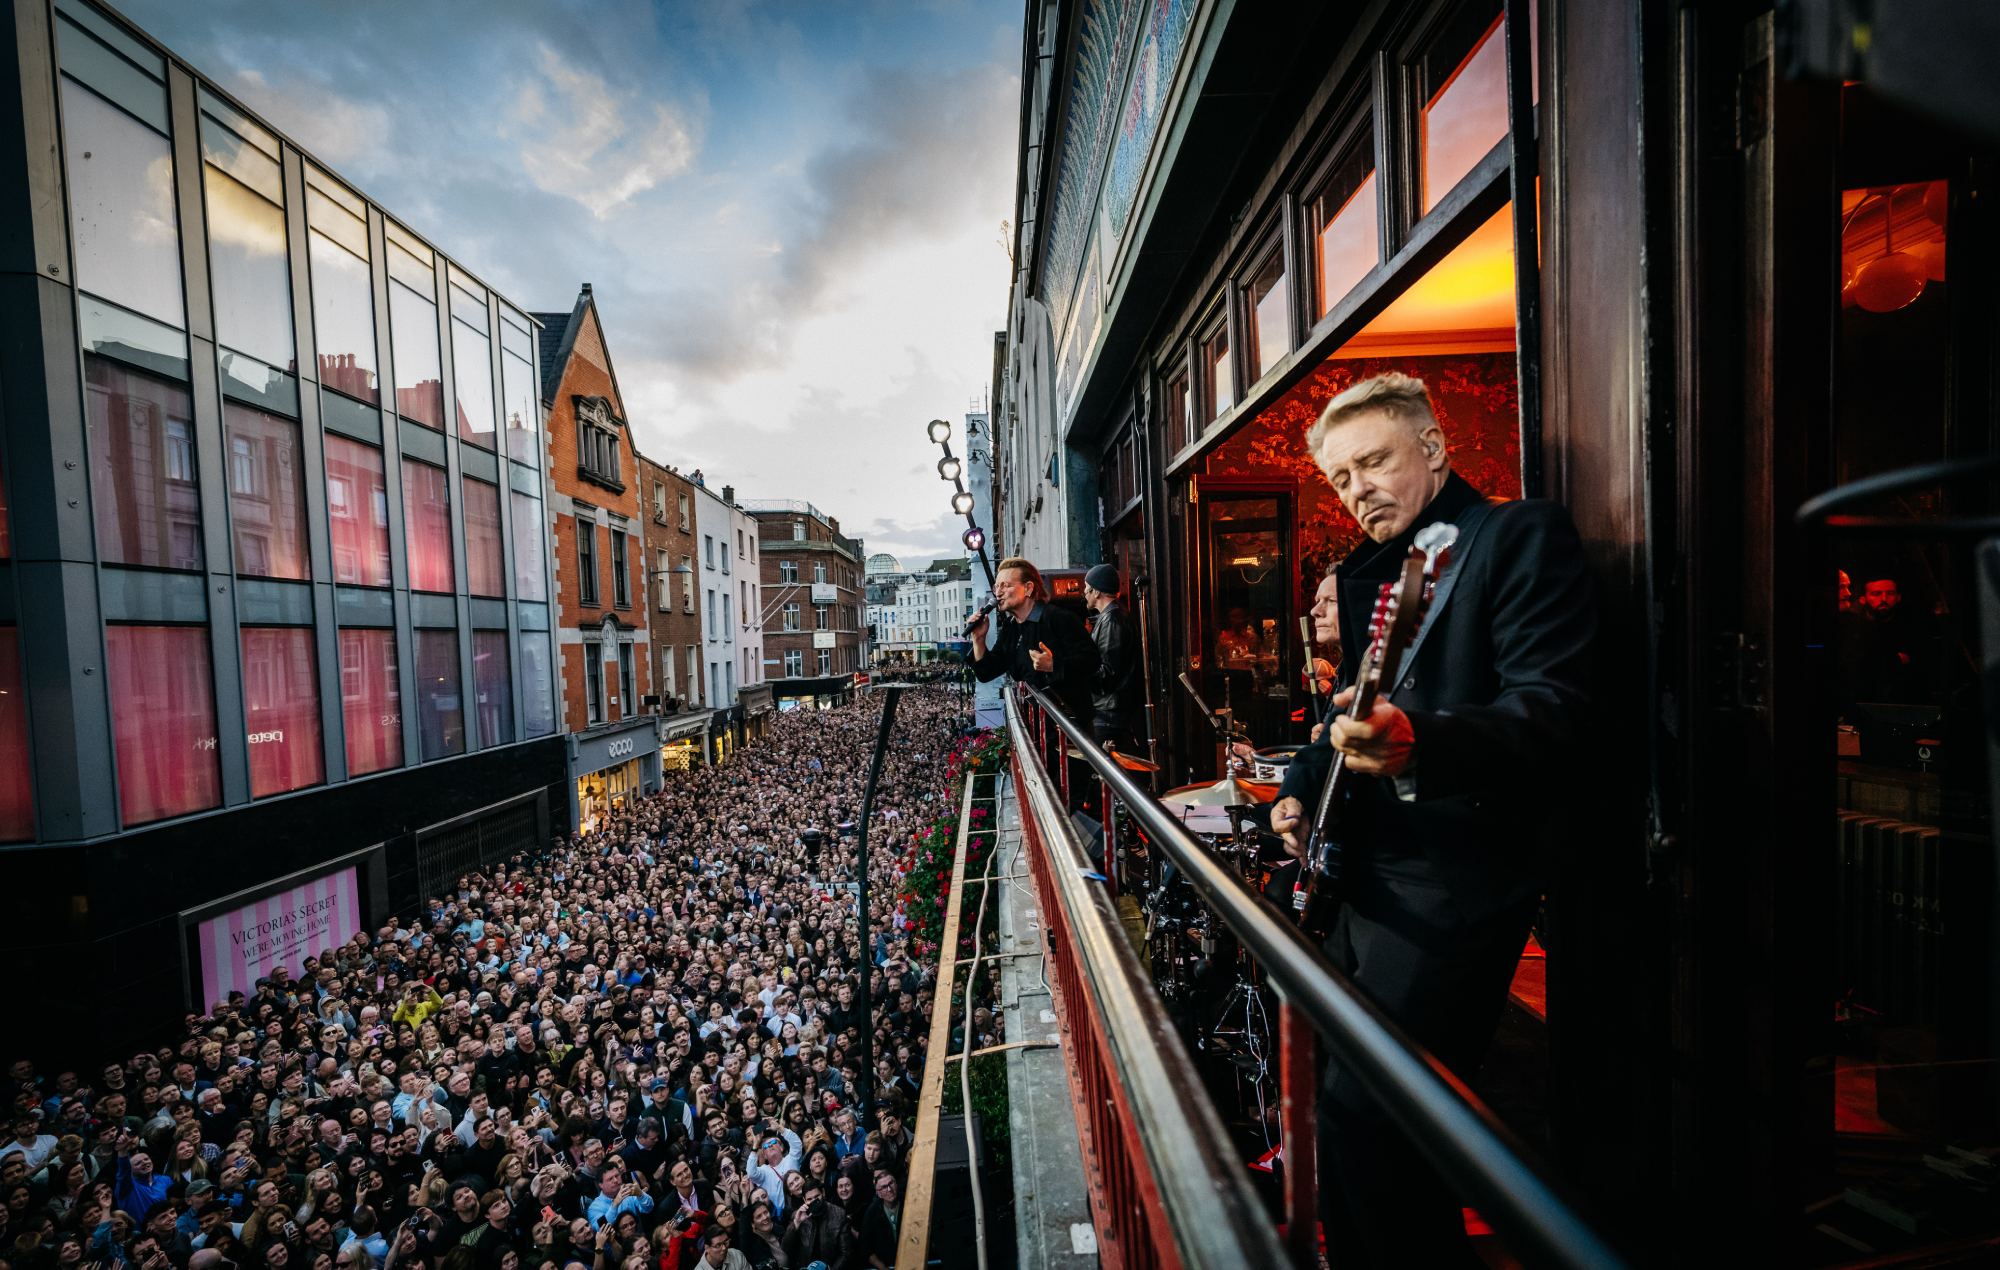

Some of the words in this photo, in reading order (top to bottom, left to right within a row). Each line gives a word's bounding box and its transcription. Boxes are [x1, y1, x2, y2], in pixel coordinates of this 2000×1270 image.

[609, 737, 633, 758] ecco
[232, 911, 297, 946] VICTORIA'S
[299, 894, 337, 919] SECRET
[271, 926, 306, 947] MOVING
[307, 914, 331, 932] HOME
